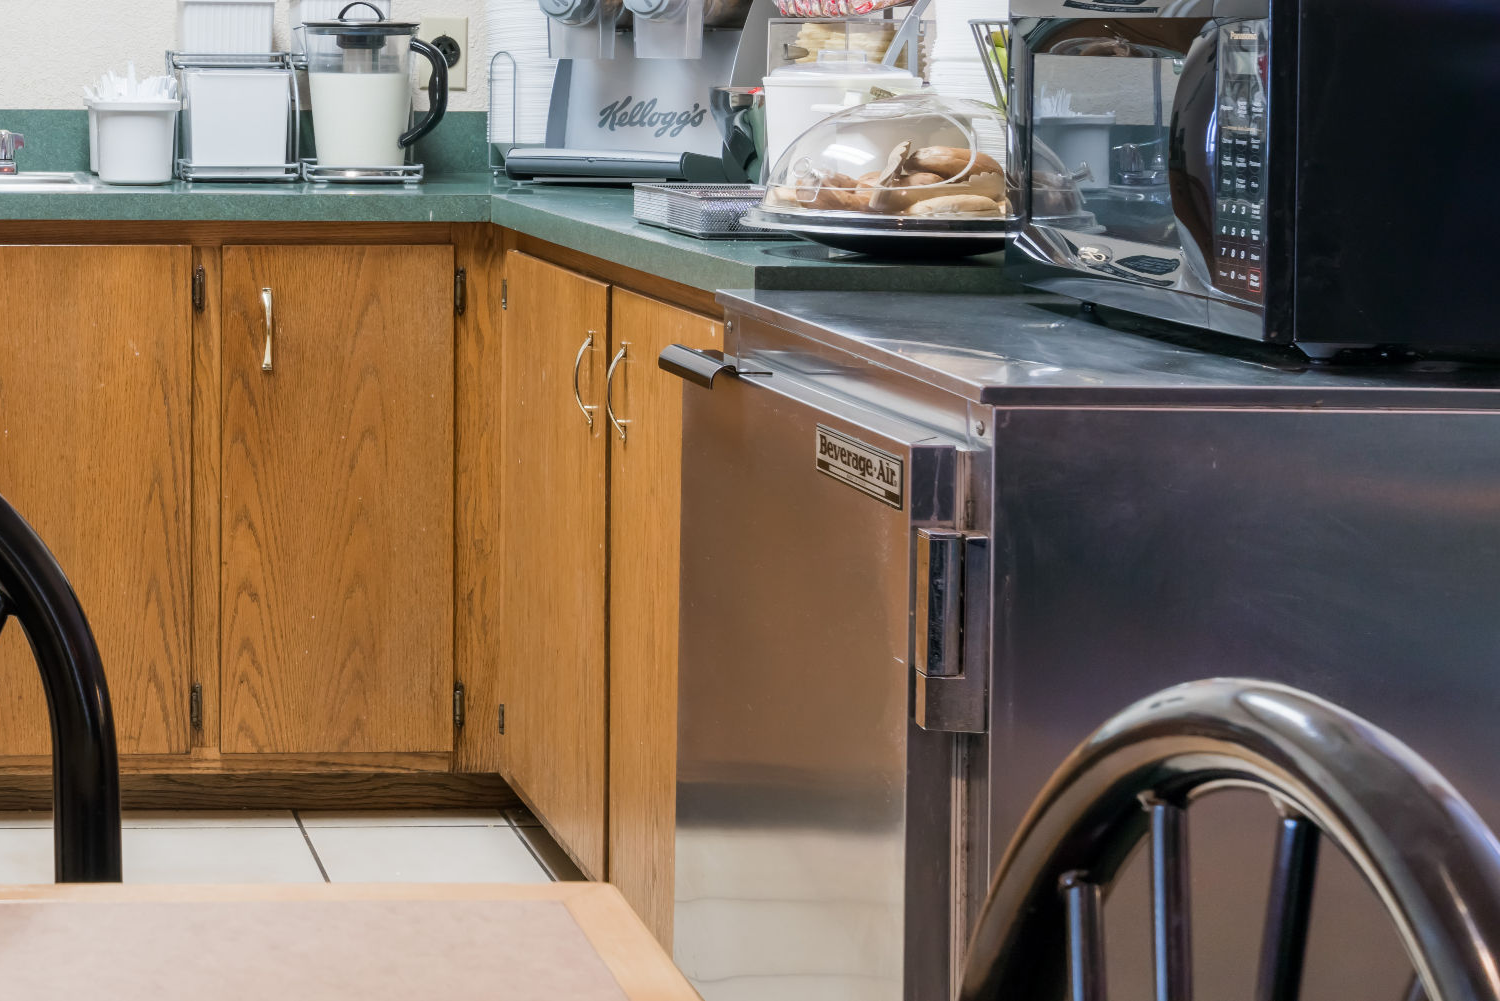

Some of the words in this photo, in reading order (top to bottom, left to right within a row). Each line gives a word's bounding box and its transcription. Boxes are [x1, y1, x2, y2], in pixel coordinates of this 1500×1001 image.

[597, 95, 708, 138] Kellogg's
[1222, 203, 1227, 212] 1
[1231, 204, 1237, 214] 2
[1241, 206, 1246, 215] 3
[1221, 225, 1227, 235] 4
[1231, 227, 1236, 236] 5
[1240, 228, 1246, 238] 6
[1221, 247, 1227, 256] 7
[1230, 248, 1236, 258] 8
[1240, 250, 1245, 260] 9
[1230, 270, 1236, 280] 0
